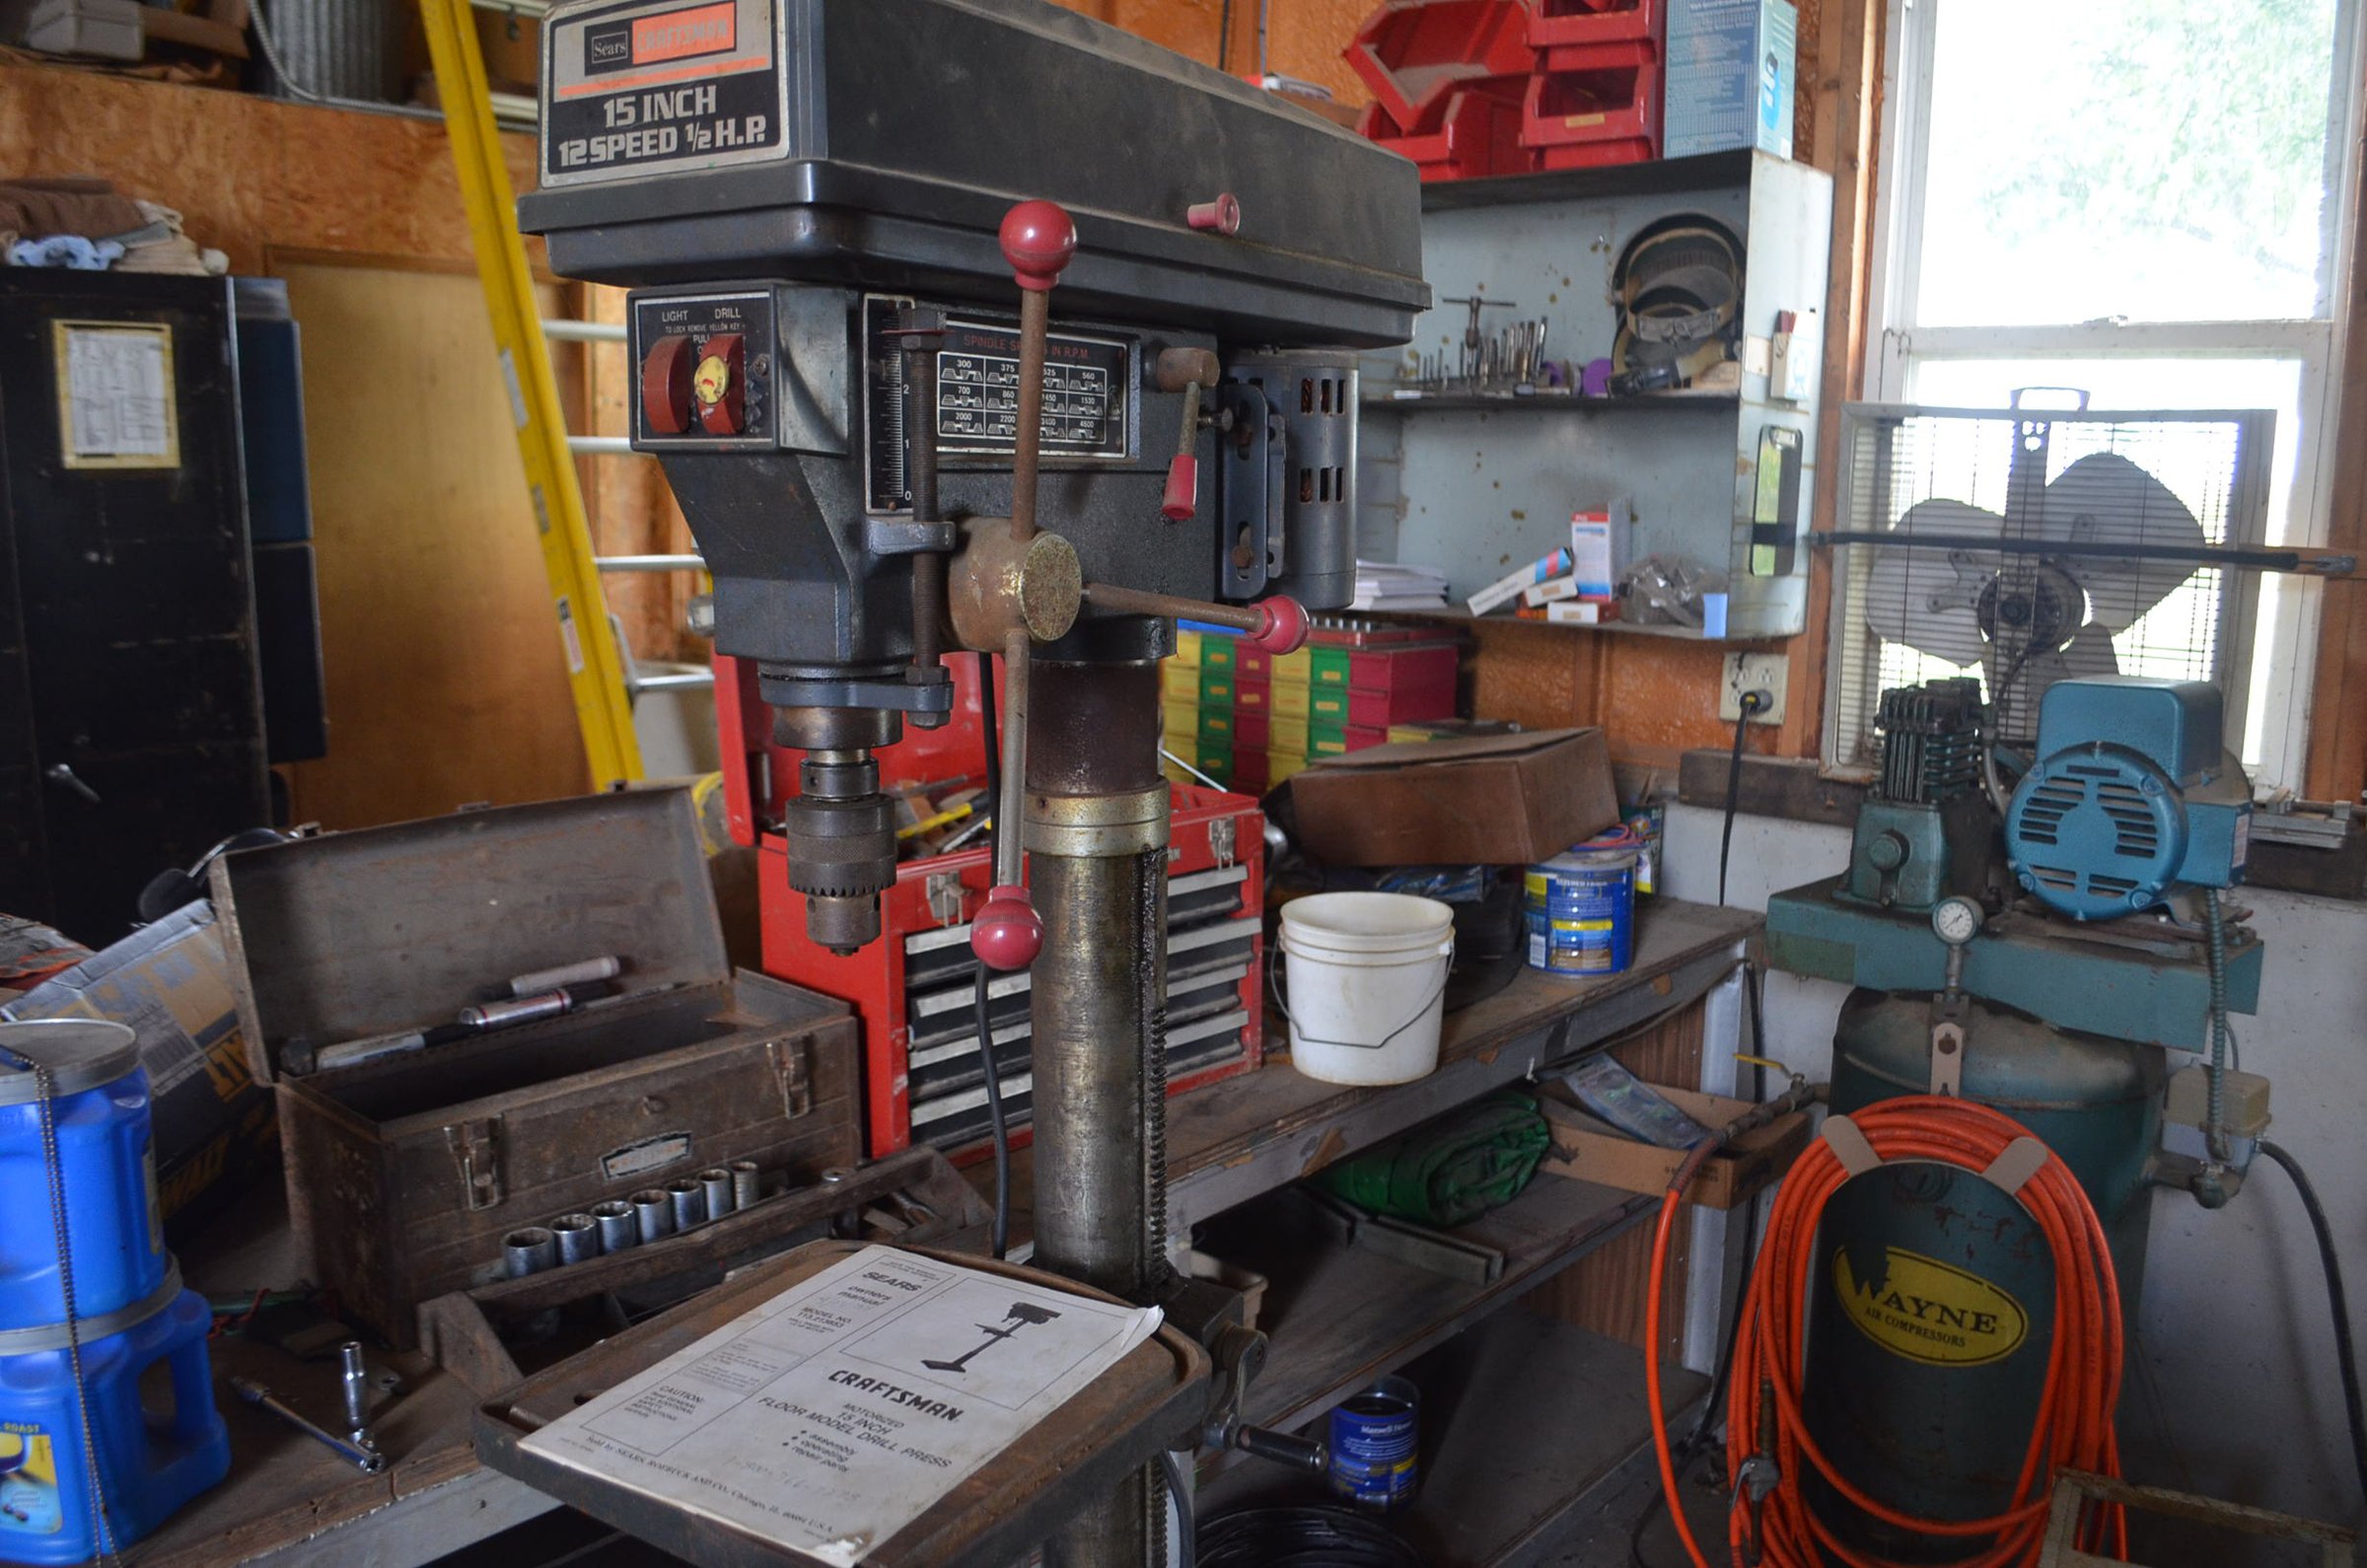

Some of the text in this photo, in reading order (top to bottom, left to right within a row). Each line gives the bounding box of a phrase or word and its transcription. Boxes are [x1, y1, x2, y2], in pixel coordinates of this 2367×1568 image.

[594, 20, 728, 57] Sears CRAFTSMAN
[604, 85, 717, 128] 15 INCH
[558, 139, 588, 167] 12
[590, 125, 679, 163] SPEED
[715, 114, 767, 148] H.P.
[662, 308, 741, 322] LIGHT DRILL
[687, 323, 706, 332] REMOVE
[964, 335, 1006, 350] SPINDLE
[957, 360, 971, 369] 300
[1001, 363, 1015, 373] 375
[1082, 372, 1095, 381] 560
[902, 384, 909, 394] 2
[958, 387, 970, 395] 700
[1002, 391, 1015, 399] 860
[1081, 396, 1096, 405] 1530
[955, 412, 972, 421] 2000
[1000, 414, 1016, 424] 2200
[904, 490, 912, 501] 0
[863, 1271, 922, 1292] SEARS
[837, 1291, 887, 1307] manual
[848, 1285, 892, 1301] owners
[802, 1307, 832, 1319] MODEL
[1852, 1281, 1998, 1335] WAYNE
[1865, 1307, 1967, 1348] AIR COMPRESSORS
[828, 1370, 965, 1421] CRAFTSMAN
[837, 1411, 892, 1435] 15 INCH
[842, 1402, 904, 1429] MOTORIZED
[757, 1396, 953, 1468] FLOOR MODEL DRILL PRESS
[810, 1433, 857, 1457] assembly
[647, 1460, 690, 1479] ROEBUCK
[693, 1474, 713, 1486] AND
[821, 1458, 850, 1473] parts
